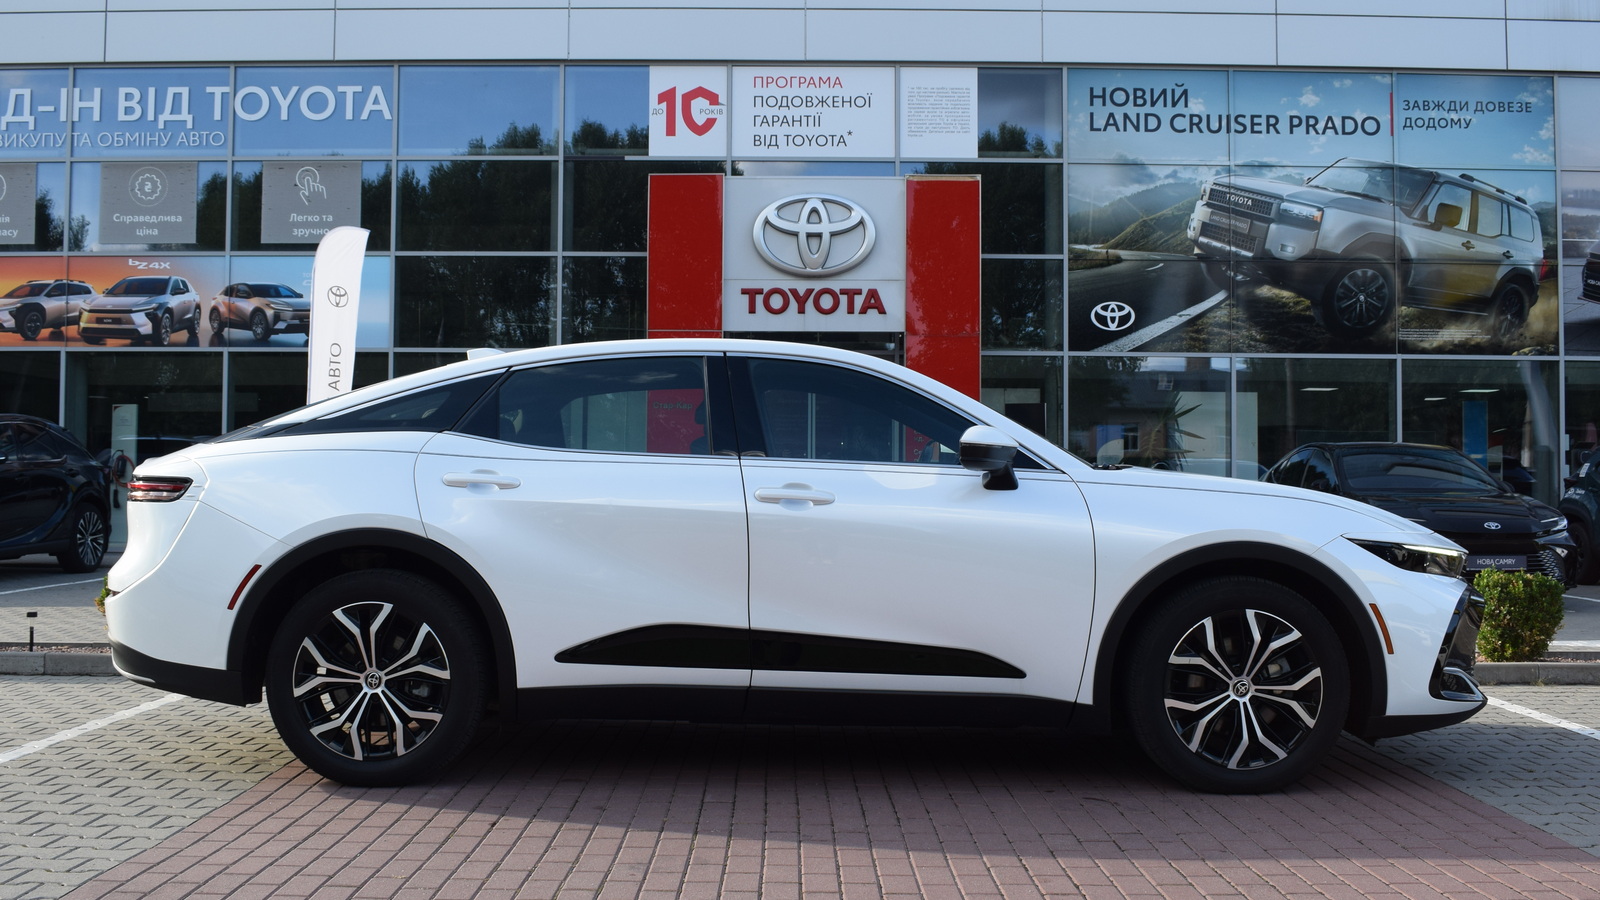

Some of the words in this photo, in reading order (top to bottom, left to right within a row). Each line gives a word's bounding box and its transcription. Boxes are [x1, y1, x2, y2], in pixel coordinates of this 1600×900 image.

[753, 75, 843, 89] ПРОГРАМА
[753, 93, 872, 110] ПОДОВЖЕНОЇ
[1088, 83, 1189, 109] НОВИЙ
[117, 86, 194, 129] ВІД
[206, 85, 393, 121] TOYOTA
[652, 108, 664, 117] ДО
[699, 108, 724, 116] РОКІВ
[1402, 99, 1470, 114] ЗАВЖДИ
[1473, 101, 1533, 115] ДОВЕЗЕ
[753, 112, 822, 128] ГАРАНТІЇ
[1088, 113, 1162, 133] LAND
[1169, 113, 1281, 136] CRUISER
[1289, 116, 1382, 138] PRADO
[1402, 116, 1473, 131] ДОДОМУ
[71, 132, 92, 148] ТА
[97, 132, 172, 148] ОБМІНУ
[176, 131, 225, 147] АВТО
[753, 134, 780, 149] ВІД
[1225, 193, 1252, 206] TOYOTA
[113, 214, 182, 225] Справедлива
[289, 213, 319, 223] Легко
[322, 214, 333, 223] та
[136, 227, 158, 237] ціна
[740, 287, 887, 315] TOYOTA
[328, 342, 342, 392] АВТО
